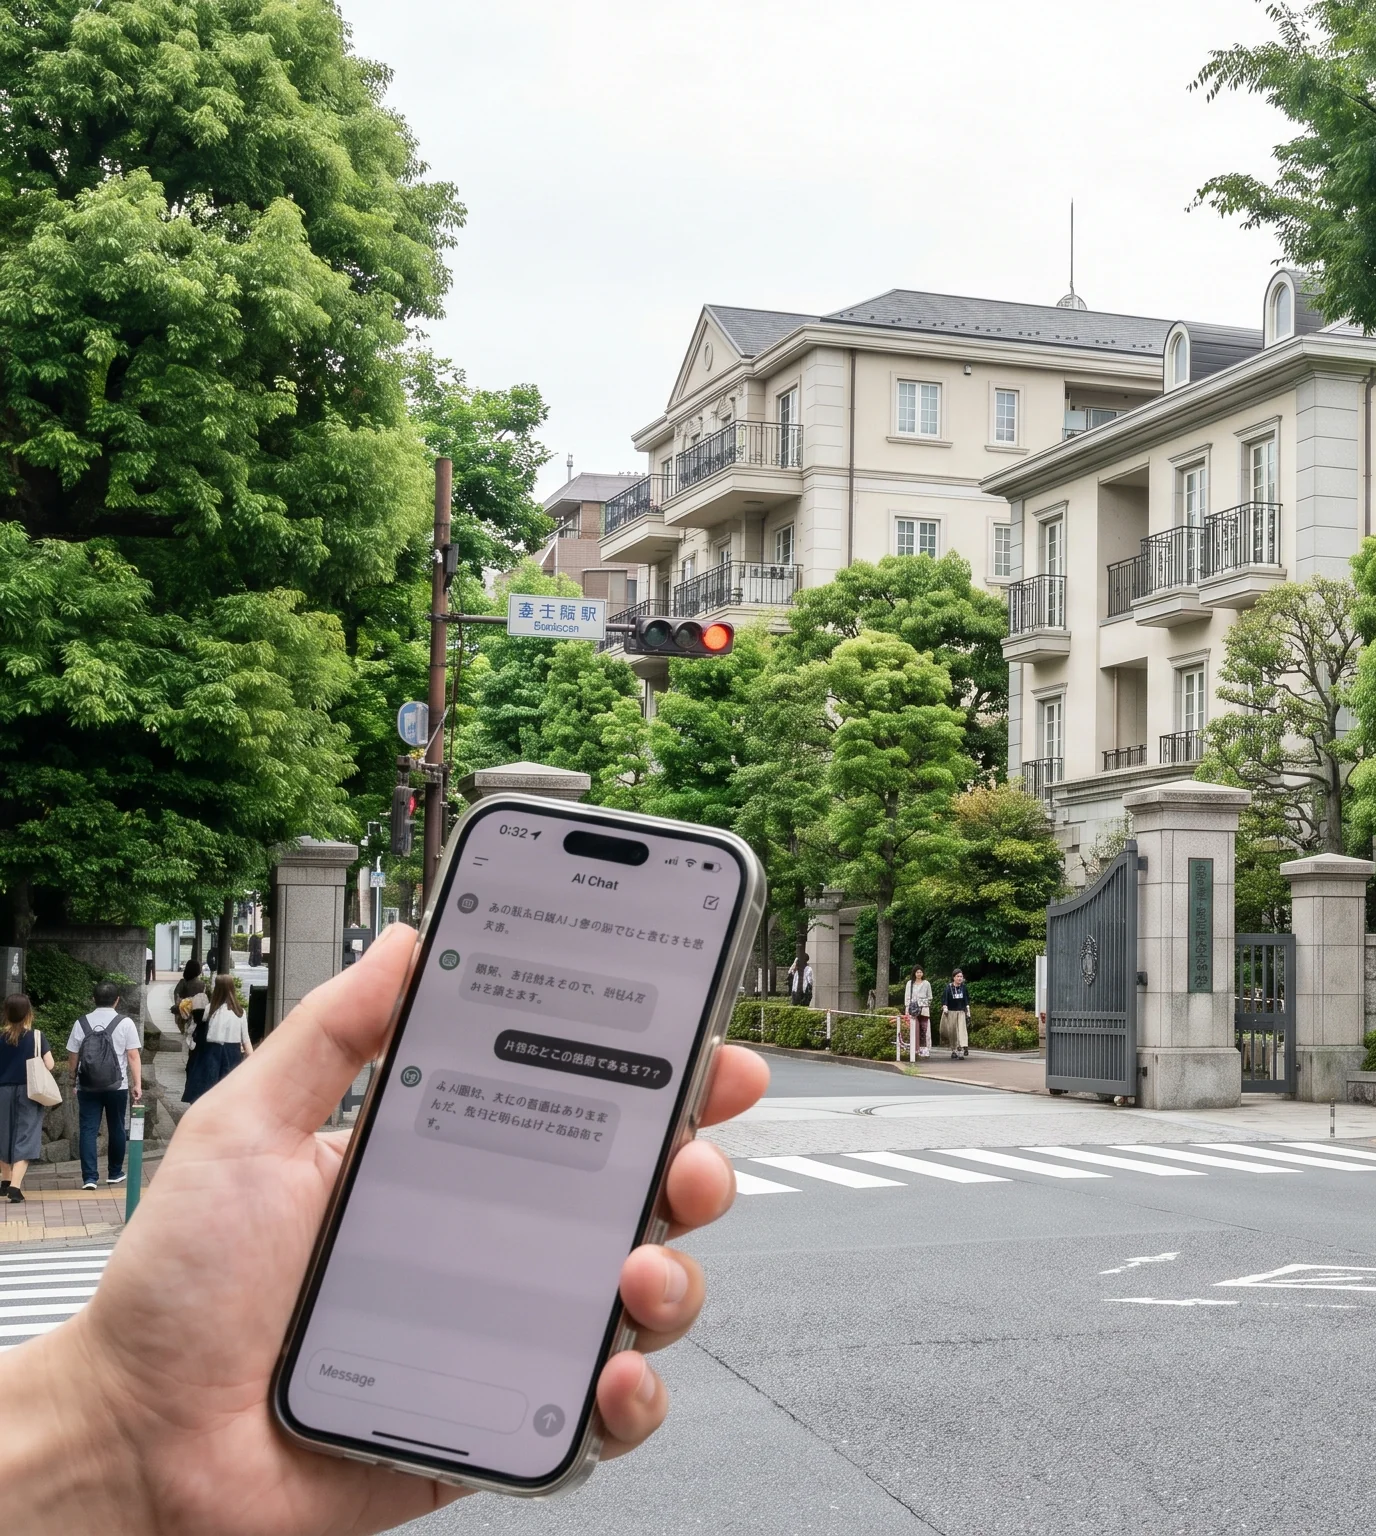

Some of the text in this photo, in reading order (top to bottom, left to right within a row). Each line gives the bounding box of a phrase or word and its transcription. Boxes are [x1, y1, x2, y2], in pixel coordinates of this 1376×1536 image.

[499, 823, 528, 839] 0:32
[571, 872, 619, 892] AI Chat
[319, 1363, 376, 1388] Message
